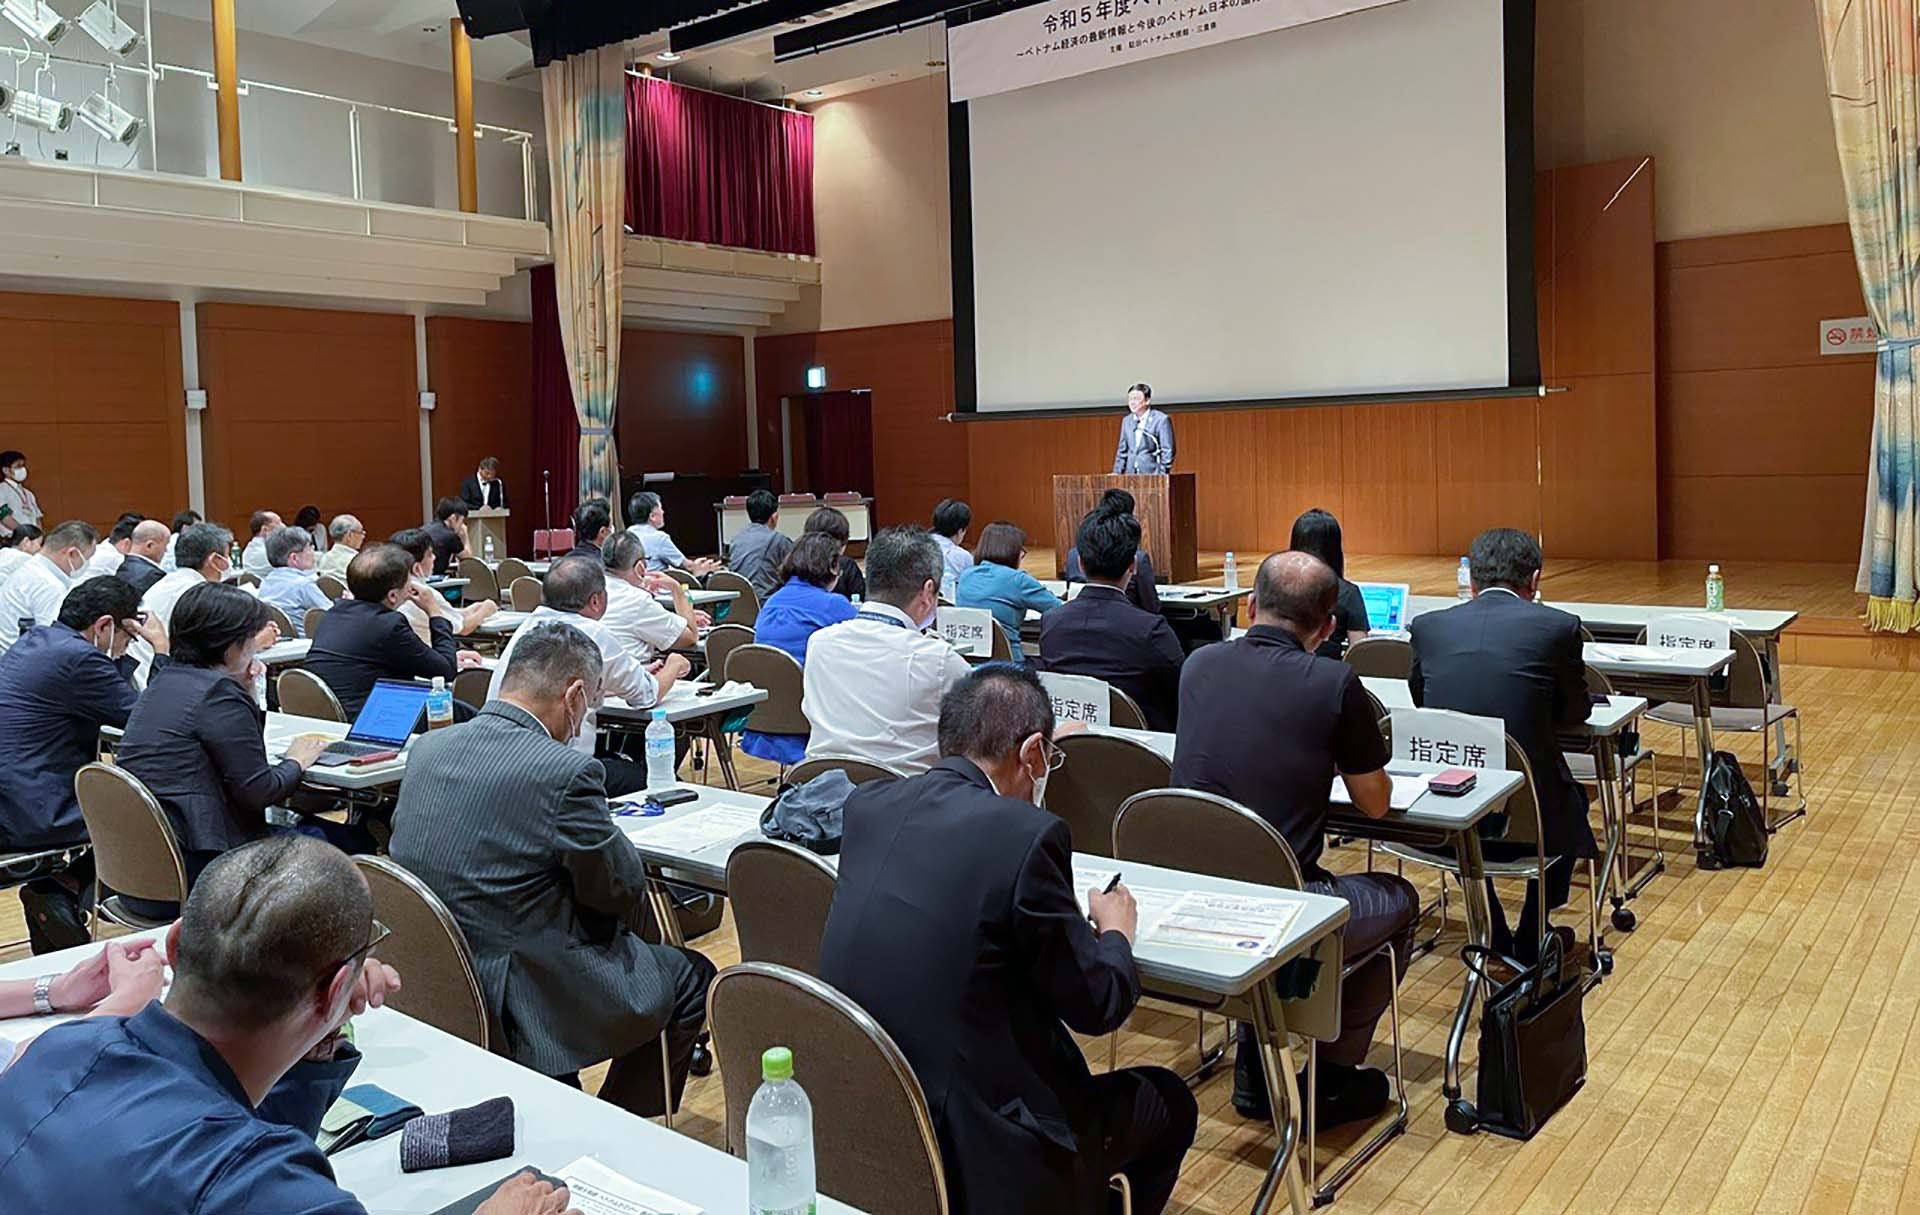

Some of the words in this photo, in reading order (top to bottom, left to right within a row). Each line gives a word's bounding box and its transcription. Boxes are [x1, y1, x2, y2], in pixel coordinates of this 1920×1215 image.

[946, 624, 983, 640] 指定席
[1050, 695, 1098, 723] 指定席
[1409, 736, 1487, 769] 指定席
